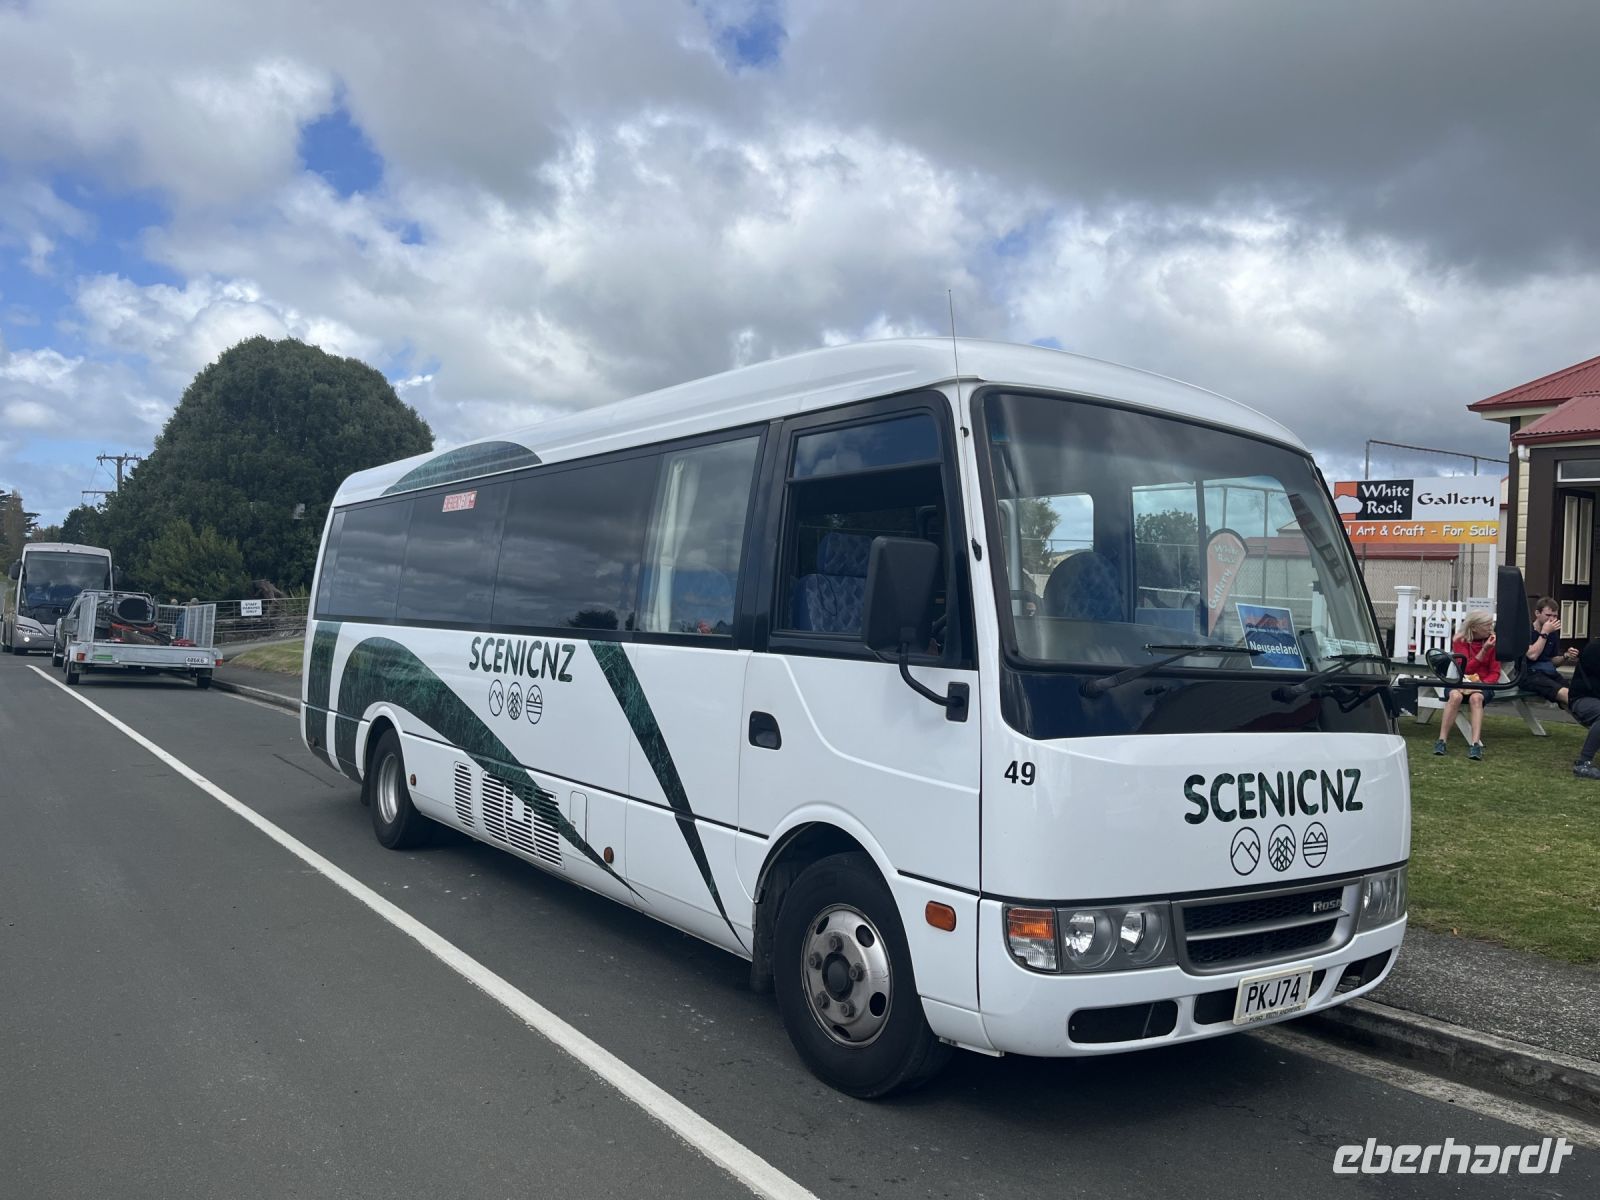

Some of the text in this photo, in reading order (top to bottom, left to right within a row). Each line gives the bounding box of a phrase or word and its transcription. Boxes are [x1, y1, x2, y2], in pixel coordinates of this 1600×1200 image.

[1361, 483, 1410, 498] White
[1417, 492, 1495, 507] Gallery
[1366, 500, 1403, 514] Rock
[1356, 525, 1376, 537] Art
[1379, 525, 1388, 536] &
[1392, 525, 1425, 537] Craft
[1442, 525, 1465, 537] For
[1469, 524, 1498, 537] Sale
[1208, 568, 1233, 609] Gallery
[1249, 640, 1299, 656] Neuseeland
[469, 636, 576, 682] SCENICNZ
[1004, 760, 1036, 786] 49
[1183, 768, 1364, 825] SCENICNZ
[1245, 976, 1302, 1013] PKJ74
